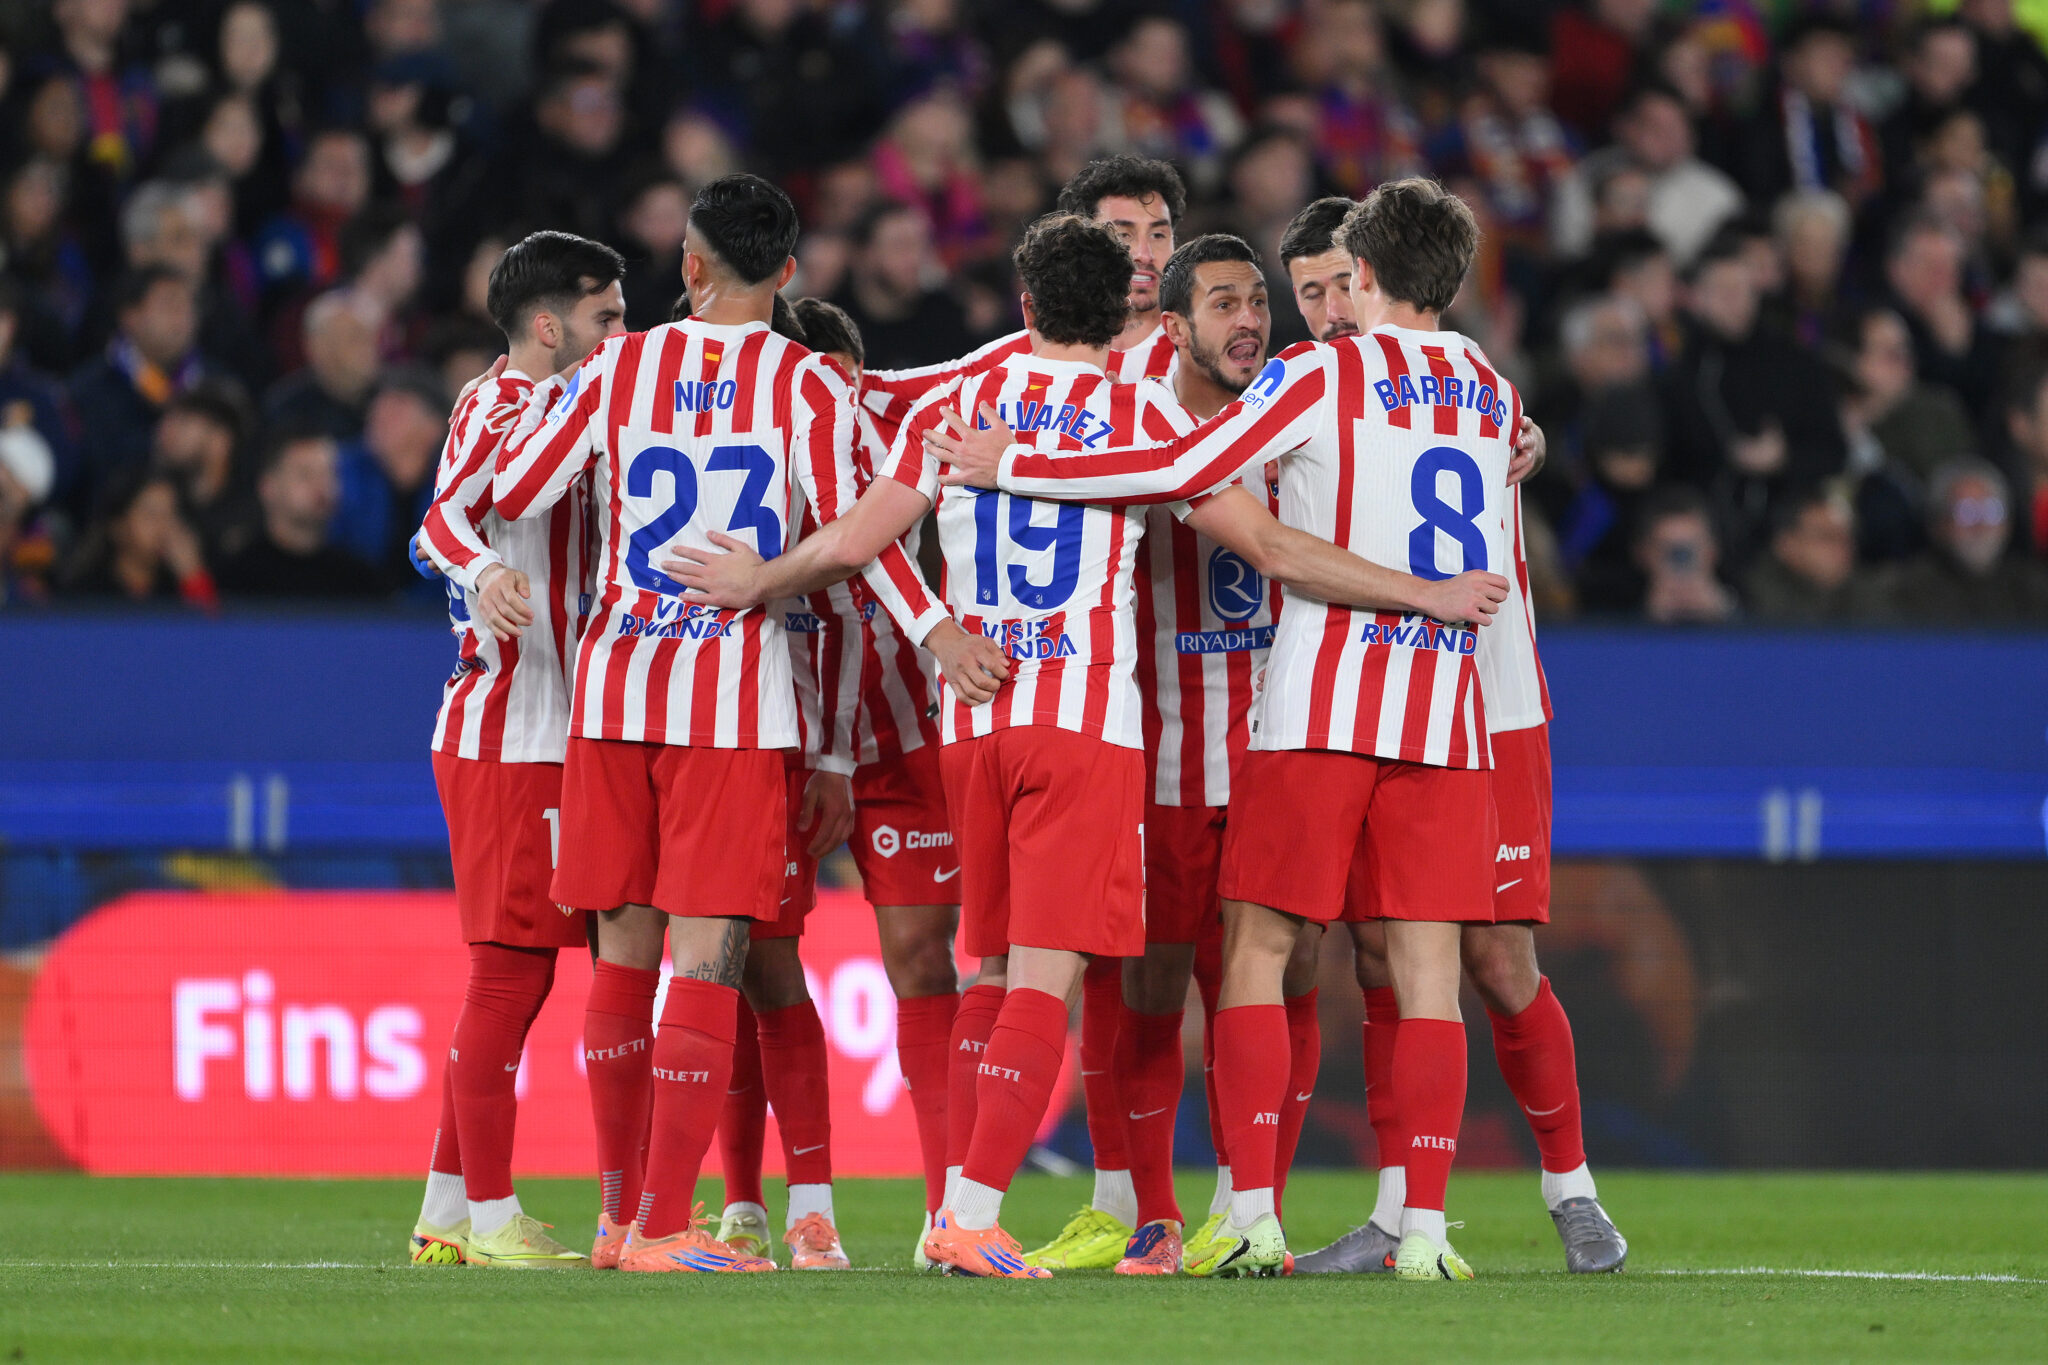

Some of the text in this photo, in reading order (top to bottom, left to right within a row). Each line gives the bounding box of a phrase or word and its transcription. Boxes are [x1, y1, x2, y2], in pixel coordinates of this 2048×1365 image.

[674, 379, 738, 413] NICO
[1372, 374, 1508, 429] BARRIOS
[625, 445, 783, 598] 23
[1408, 446, 1489, 581] 8
[963, 484, 1086, 610] 19
[1180, 630, 1256, 653] RIYADH
[170, 969, 428, 1101] Fins
[586, 1038, 645, 1061] ATLETI
[652, 1066, 709, 1083] ATLETI
